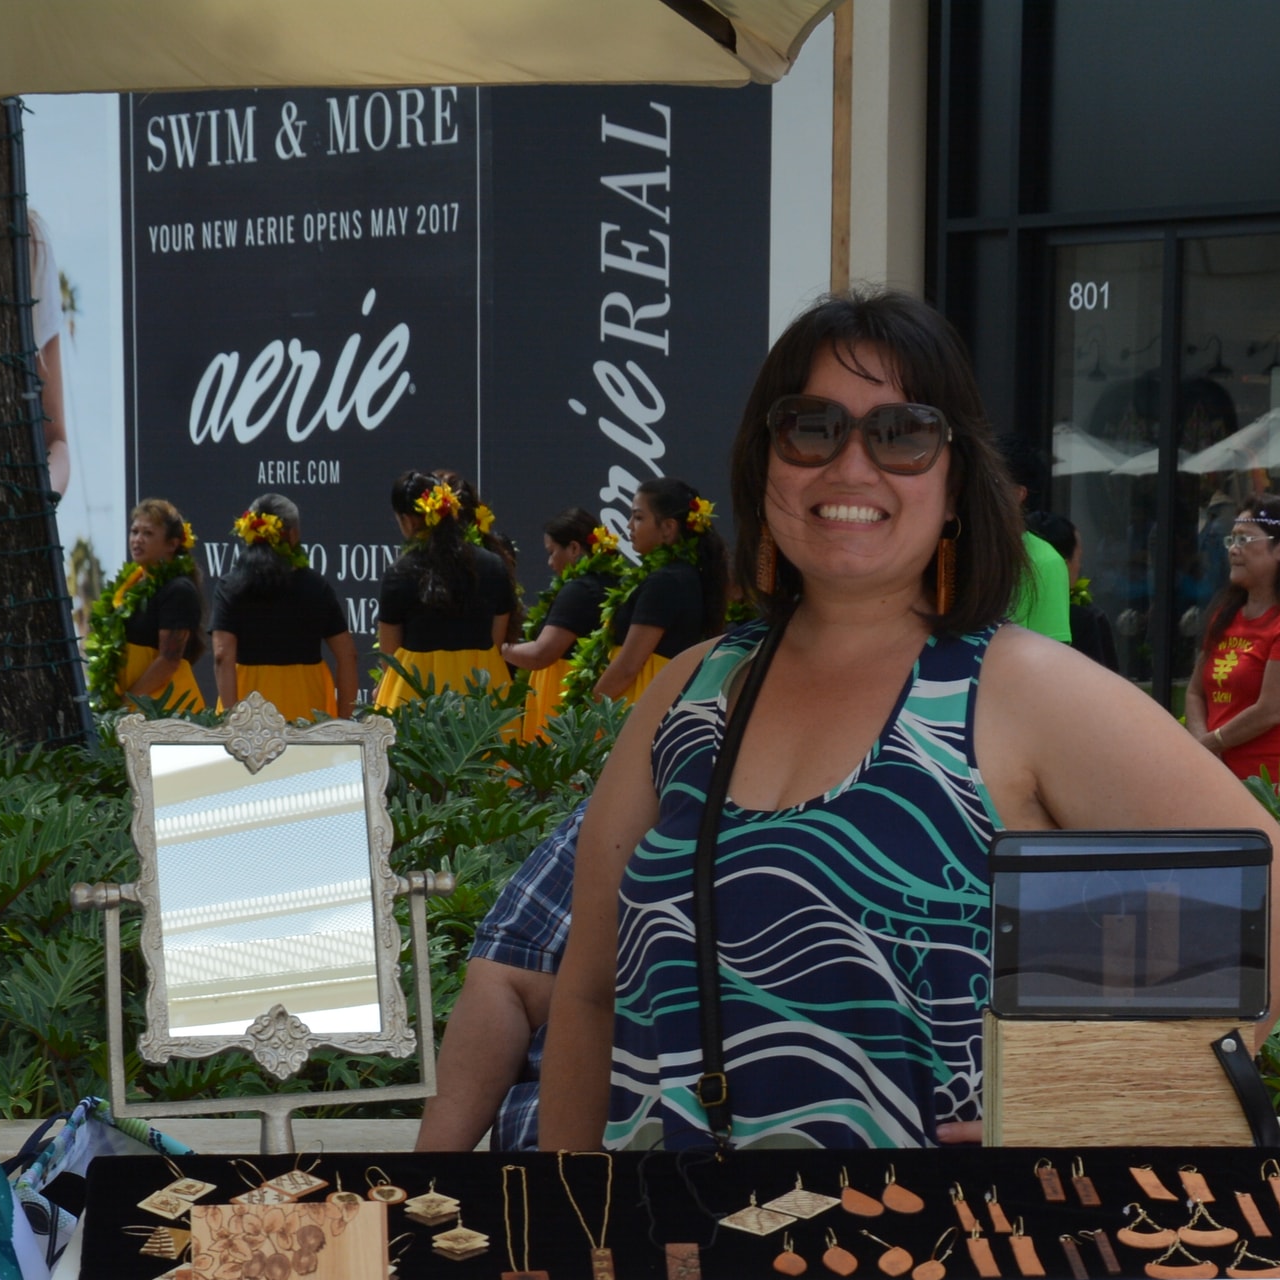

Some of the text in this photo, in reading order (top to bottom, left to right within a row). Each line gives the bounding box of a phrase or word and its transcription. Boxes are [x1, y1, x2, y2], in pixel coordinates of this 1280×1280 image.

[146, 86, 460, 172] SWIM & MORE
[149, 203, 460, 253] YOUR NEW AERIE OPENS MAY 2017
[600, 101, 672, 357] REAL
[1069, 281, 1110, 311] 801
[258, 459, 341, 486] AERIE.COM
